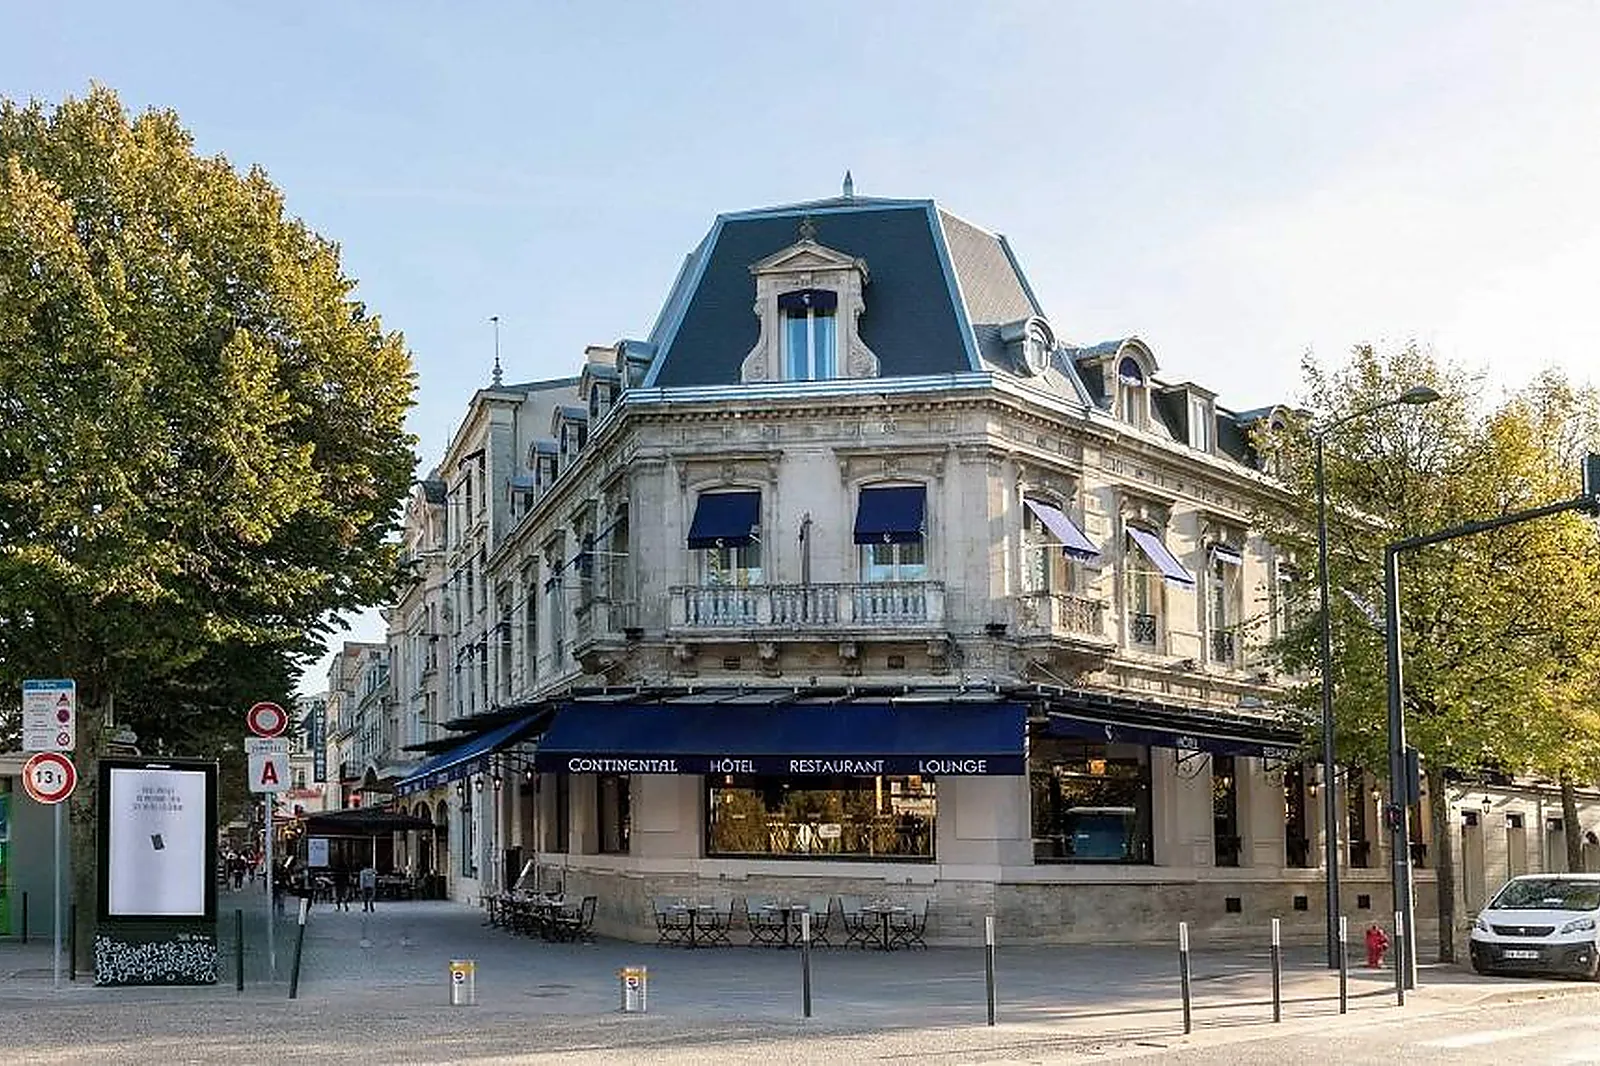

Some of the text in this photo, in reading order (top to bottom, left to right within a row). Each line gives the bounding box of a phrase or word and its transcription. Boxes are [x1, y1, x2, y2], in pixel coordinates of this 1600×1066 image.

[261, 760, 279, 785] A
[568, 757, 987, 773] CONTINENTAL HÔTEL RESTAURANT LOUNGE
